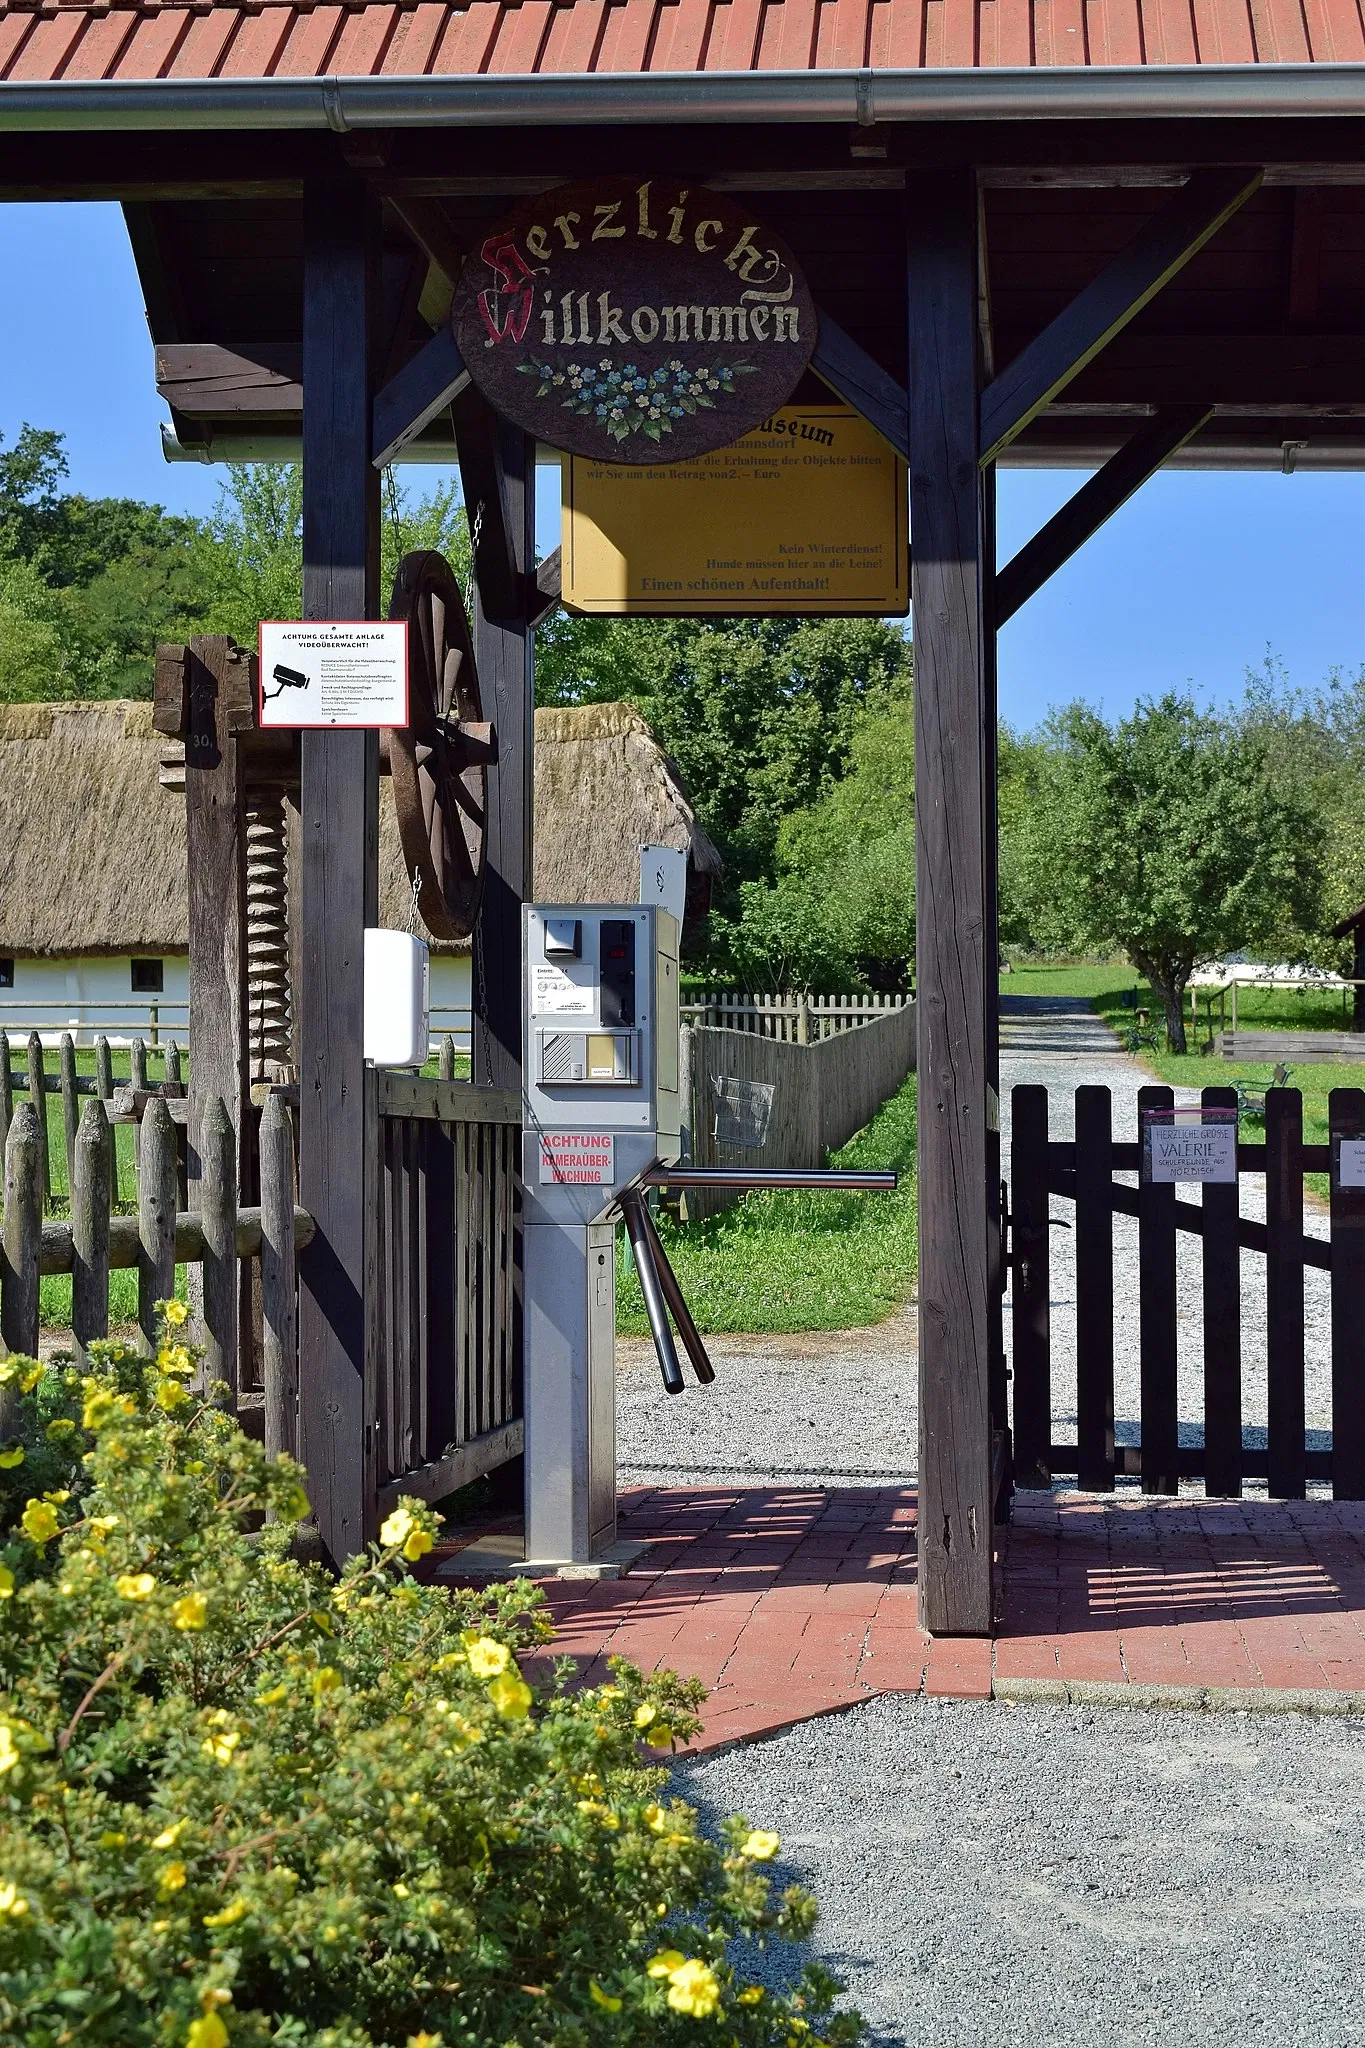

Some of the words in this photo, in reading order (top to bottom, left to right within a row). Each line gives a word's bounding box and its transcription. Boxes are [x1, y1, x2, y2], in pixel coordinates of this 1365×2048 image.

[480, 180, 794, 304] Herzlich
[478, 286, 800, 348] Willkommen
[759, 418, 835, 447] useum
[704, 455, 721, 466] die
[724, 455, 778, 468] Erhaltung
[781, 455, 800, 466] der
[803, 455, 847, 467] Objekte
[850, 455, 882, 466] bitten
[586, 469, 604, 479] wir
[606, 469, 623, 479] Sie
[626, 471, 643, 479] um
[646, 469, 666, 479] den
[669, 469, 706, 481] Betrag
[754, 469, 781, 479] Euro
[778, 543, 804, 554] Kein
[808, 543, 883, 554] Winterdienst!
[706, 558, 743, 569] Hunde
[746, 558, 785, 569] müssen
[788, 558, 812, 569] hier
[813, 561, 826, 569] an
[829, 558, 846, 569] die
[849, 558, 883, 569] Leine!
[641, 577, 683, 591] Einen
[687, 577, 745, 591] schönen
[749, 577, 830, 591] Aufenthalt!
[1156, 1129, 1199, 1140] HERZLICHE
[542, 1135, 611, 1148] ACHTUNG
[542, 1152, 611, 1167] KAMERAÜBER-
[551, 1170, 601, 1183] WACHUNG
